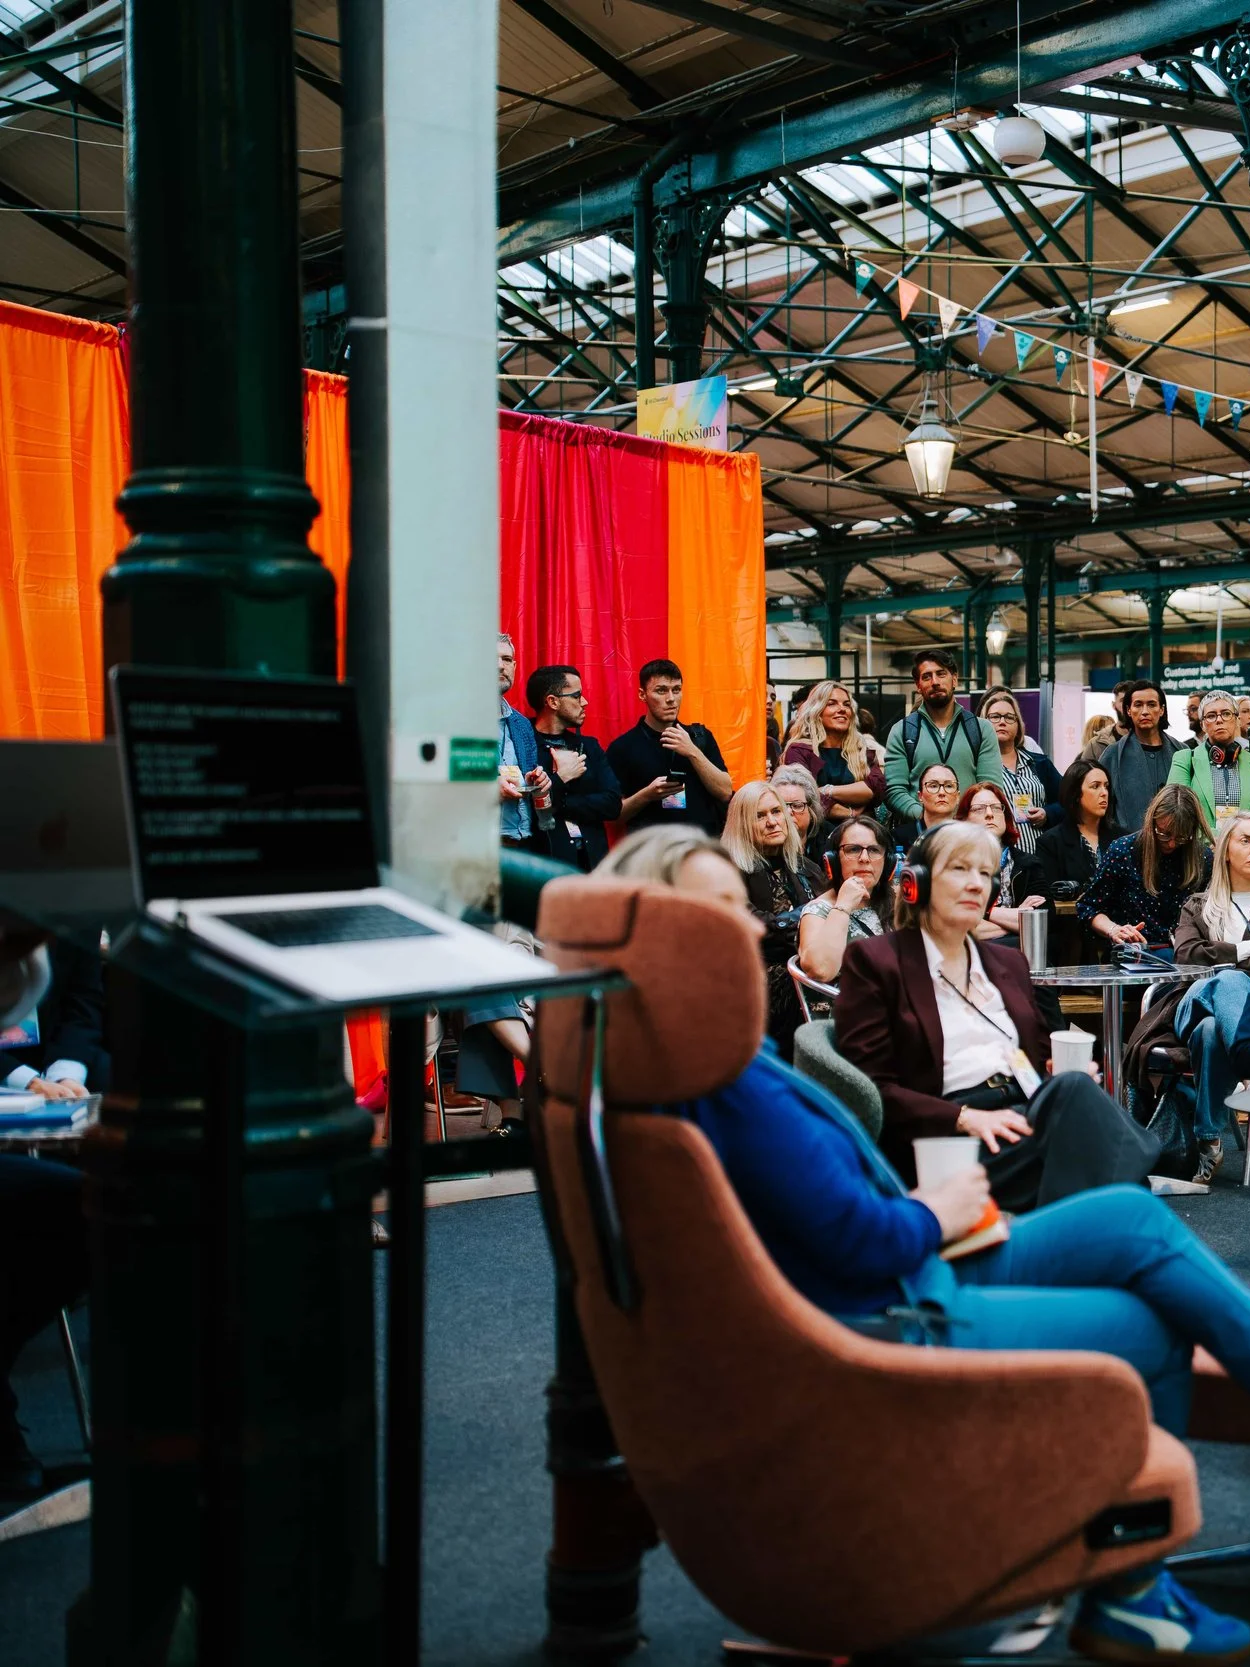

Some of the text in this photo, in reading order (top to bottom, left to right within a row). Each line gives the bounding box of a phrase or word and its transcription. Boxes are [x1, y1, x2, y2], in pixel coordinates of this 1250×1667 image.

[677, 424, 721, 442] Sessions
[1163, 667, 1199, 677] Customer
[1224, 663, 1240, 674] and
[1178, 678, 1212, 689] changing
[1213, 675, 1245, 687] facilities
